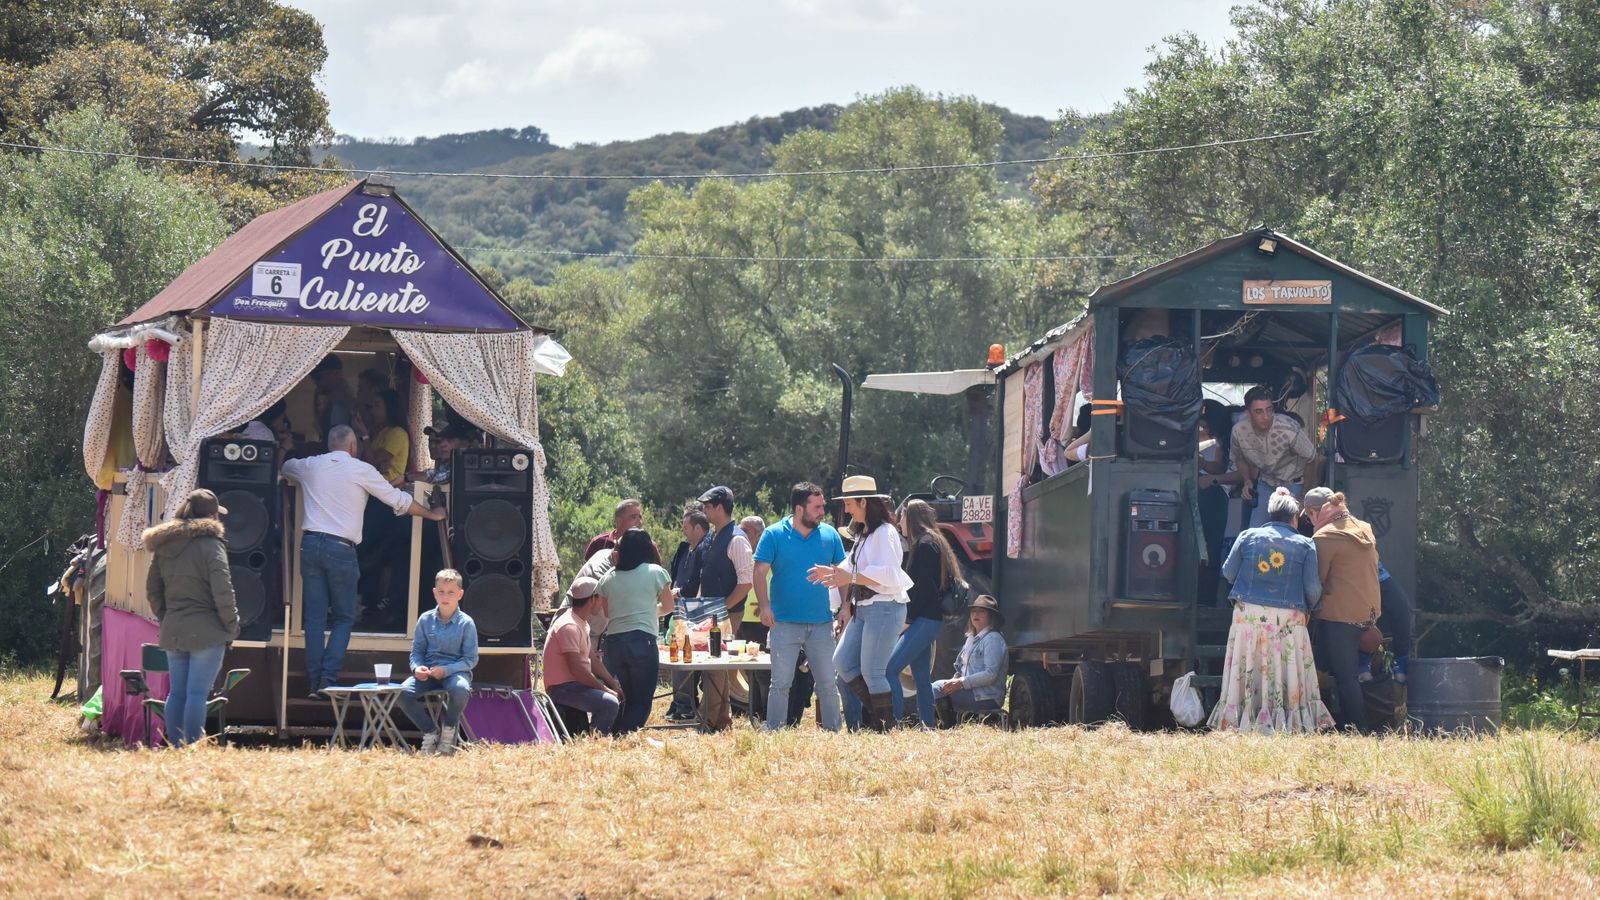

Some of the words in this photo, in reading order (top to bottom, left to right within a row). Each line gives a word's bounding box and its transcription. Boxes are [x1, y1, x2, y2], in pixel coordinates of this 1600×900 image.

[352, 203, 388, 237] El
[320, 238, 426, 275] Punto
[264, 268, 290, 276] CARRETA
[270, 275, 283, 295] 6
[299, 275, 431, 315] Caliente
[1247, 286, 1265, 301] LOS
[234, 298, 250, 306] Don
[963, 498, 975, 509] CA
[979, 497, 991, 509] VE
[962, 509, 991, 521] 29828
